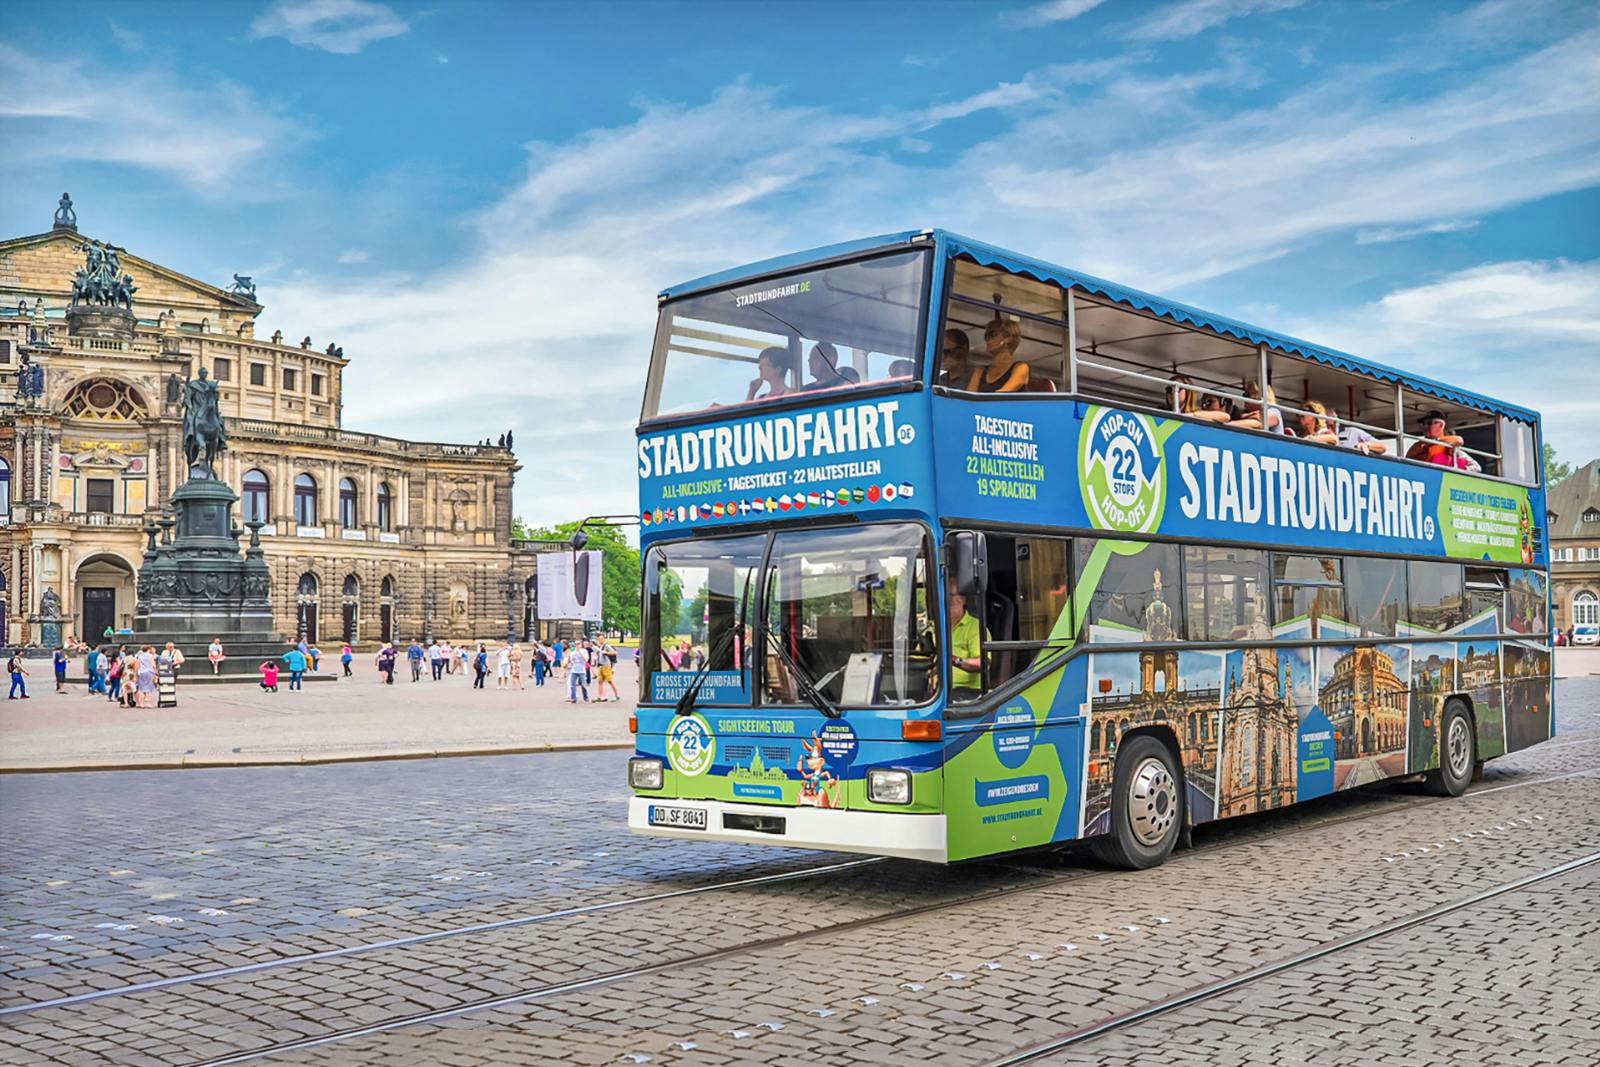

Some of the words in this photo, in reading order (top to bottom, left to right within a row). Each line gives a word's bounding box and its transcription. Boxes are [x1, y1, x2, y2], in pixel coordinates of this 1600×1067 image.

[638, 401, 899, 479] STADTRUNDFAHRT
[900, 428, 912, 440] DE
[974, 415, 1034, 440] TAGESTICKET
[1100, 413, 1144, 446] HOP-ON
[971, 436, 1039, 461] ALL-INCLUSIVE
[966, 455, 979, 474] 22
[979, 457, 1045, 481] HALTESTELLEN
[1111, 447, 1136, 482] 22
[662, 479, 723, 499] ALL-INCLUSIVE
[727, 471, 787, 491] TAGESTICKET
[793, 469, 806, 484] 22
[807, 459, 881, 482] HALTESTELLEN
[976, 477, 988, 496] 19
[989, 480, 1036, 500] SPRACHEN
[1113, 482, 1136, 496] STOPS
[1178, 441, 1425, 541] STADTRUNDFAHRT
[1101, 494, 1147, 527] HOP-OFF
[655, 675, 682, 687] GROSSE
[655, 688, 665, 700] 22
[665, 687, 715, 700] HALTELLEN
[718, 720, 771, 733] SIGHTSEEING
[771, 720, 795, 733] TOUR
[683, 735, 697, 750] 22
[670, 809, 681, 822] SF
[683, 811, 704, 825] 8041
